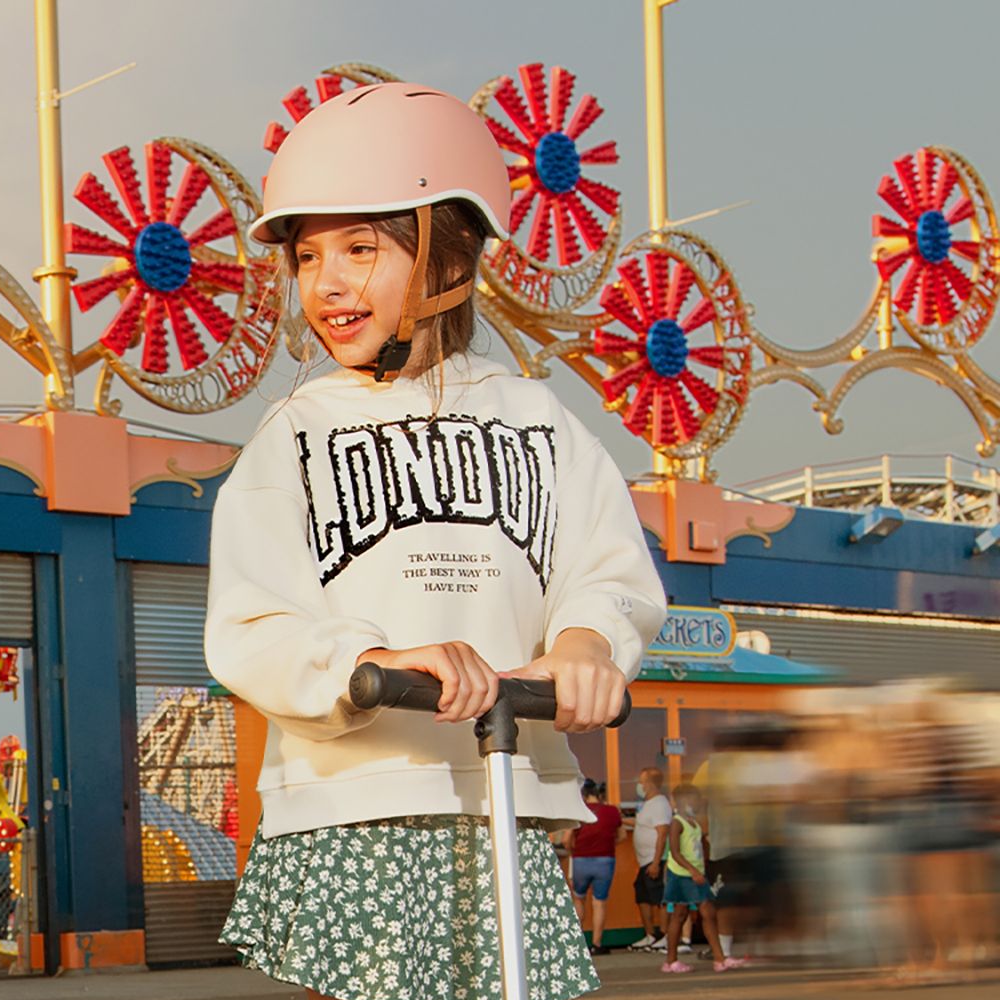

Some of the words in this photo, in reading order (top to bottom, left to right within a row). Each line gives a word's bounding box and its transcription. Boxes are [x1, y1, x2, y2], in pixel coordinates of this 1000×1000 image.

[296, 413, 558, 597] LONDON
[407, 552, 478, 563] TRAVELLING
[481, 553, 492, 563] IS
[402, 568, 427, 578] THE
[430, 567, 456, 577] BEST
[457, 568, 482, 578] WAY
[485, 568, 501, 577] TO
[424, 582, 454, 592] HAVE
[456, 583, 478, 593] FUN
